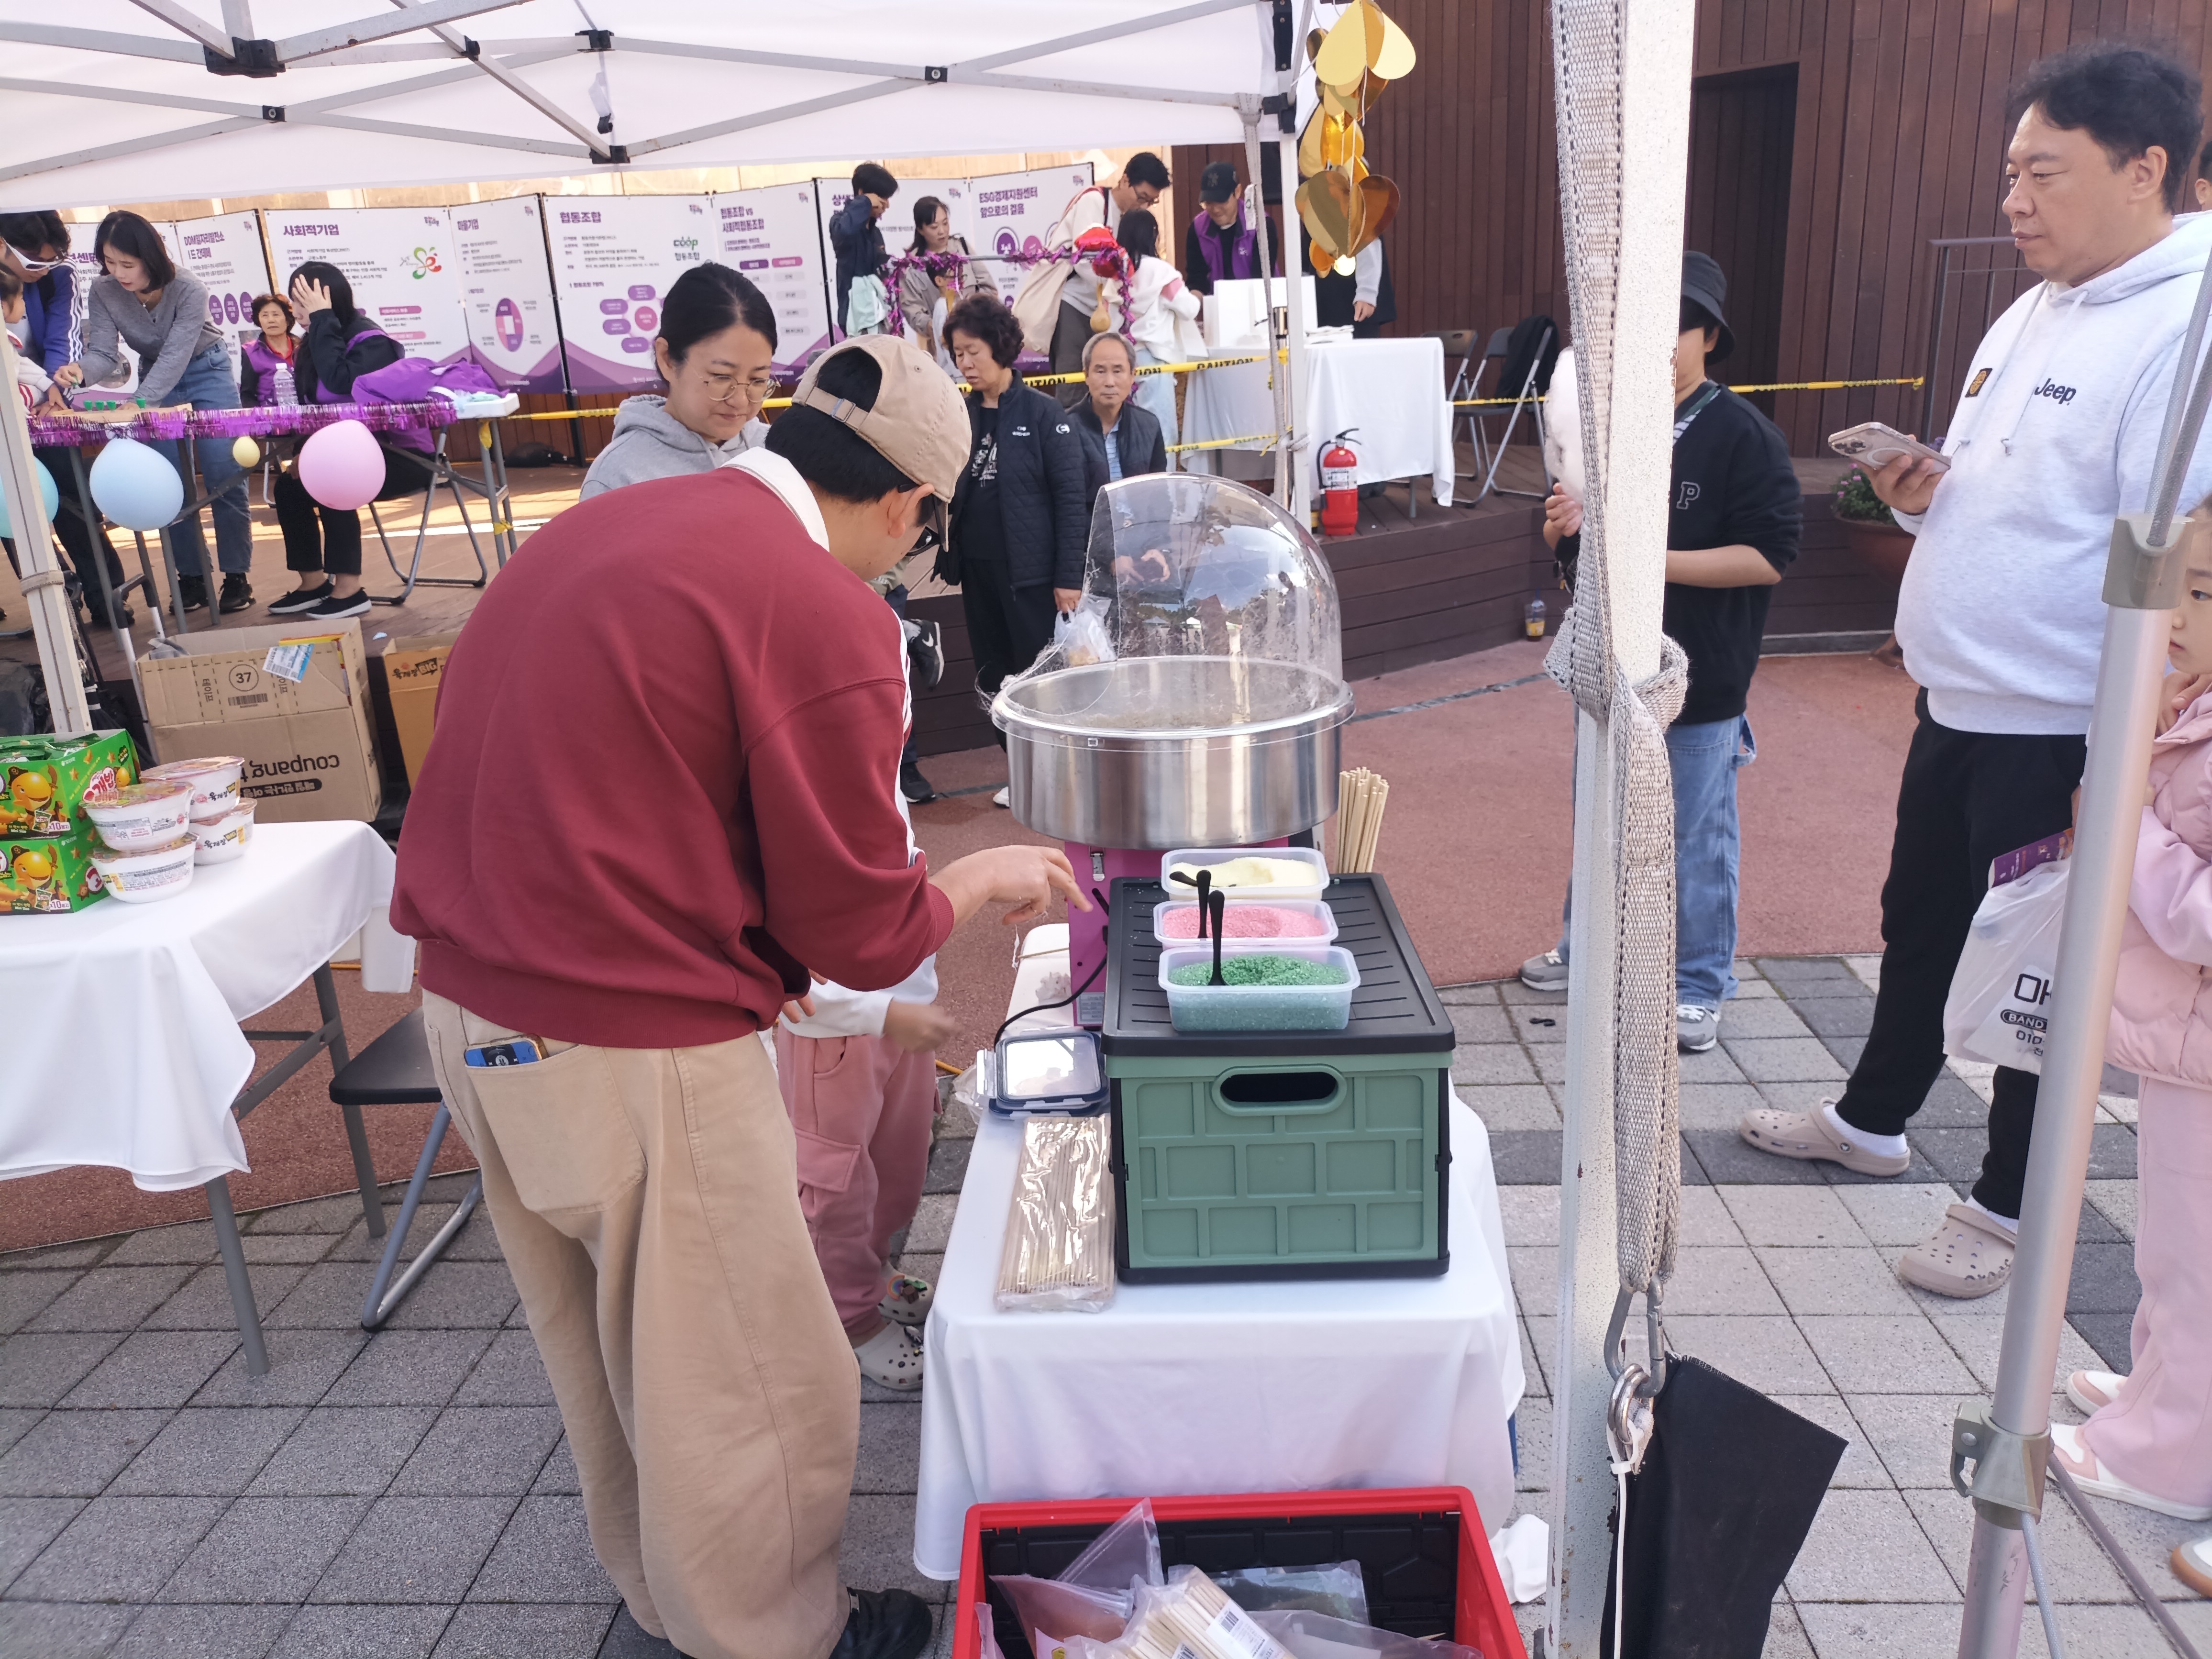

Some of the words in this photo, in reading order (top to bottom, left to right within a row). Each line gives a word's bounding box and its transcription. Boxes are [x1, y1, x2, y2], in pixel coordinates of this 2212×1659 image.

[979, 187, 1038, 203] ESG경제지원센터
[720, 206, 744, 219] 협동조합
[980, 205, 1009, 218] 앞으로의
[1010, 203, 1024, 215] 걸음
[560, 212, 601, 223] 협동조합
[283, 224, 339, 236] 사회적기업
[457, 219, 479, 231] 마을기업
[723, 219, 764, 232] 사회적협동조합
[675, 252, 700, 261] 협동조합
[2034, 378, 2077, 405] Jeep
[1676, 481, 1700, 510] P
[236, 672, 252, 684] 37
[276, 675, 288, 694] 이프
[202, 678, 214, 702] 테이프
[249, 754, 340, 778] coupang
[208, 790, 228, 801] 육개장
[204, 838, 226, 849] 육개장
[2009, 1013, 2044, 1029] BAND
